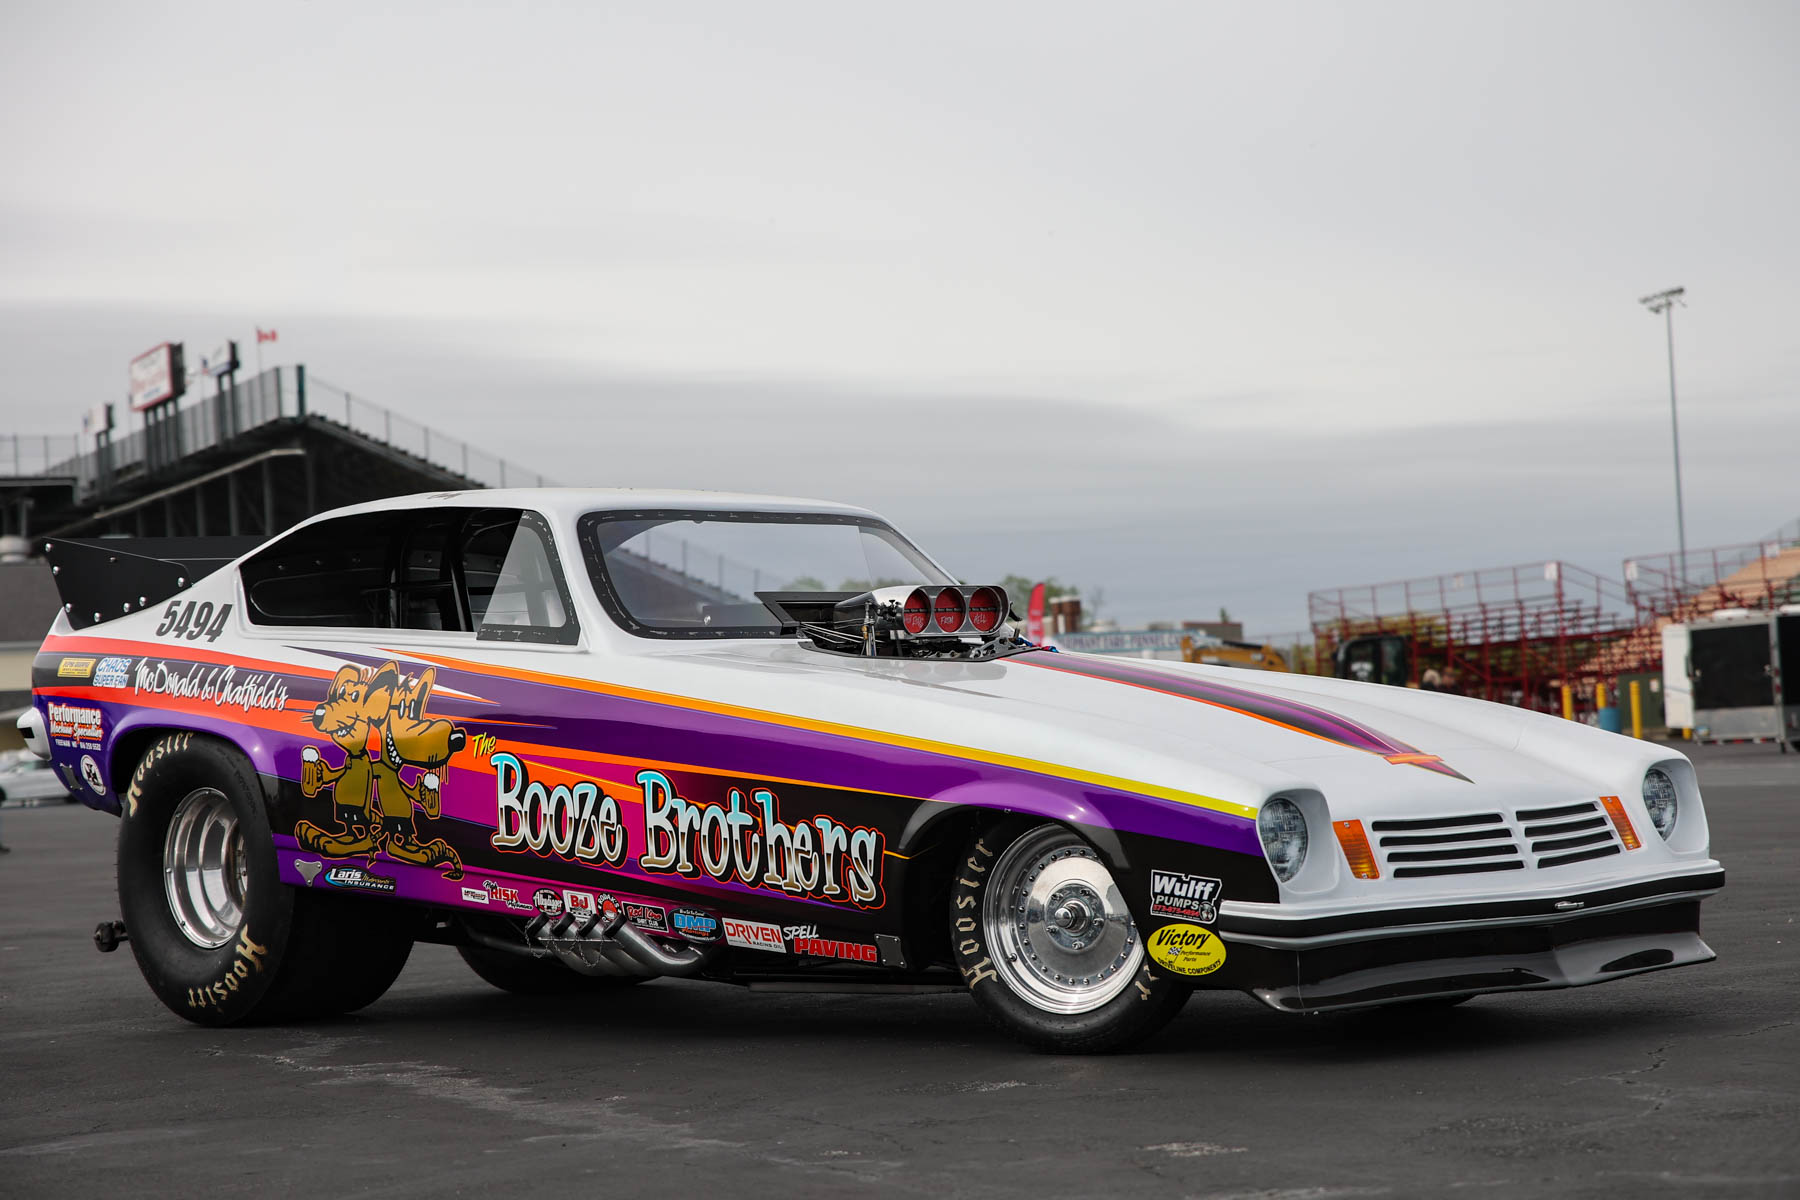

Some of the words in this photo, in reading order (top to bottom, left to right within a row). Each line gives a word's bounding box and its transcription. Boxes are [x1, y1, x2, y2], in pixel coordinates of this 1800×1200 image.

[155, 600, 233, 643] 5494
[96, 657, 132, 673] CHAOS
[93, 673, 114, 687] SUPER
[115, 674, 129, 688] FAN
[134, 657, 205, 699] McDonald
[215, 664, 288, 711] Chatfield's
[48, 702, 102, 725] Performance
[472, 732, 495, 758] The
[127, 731, 193, 817] Hoosier
[490, 752, 626, 864] Booze
[636, 769, 882, 906] Brothers
[330, 868, 362, 881] Laris
[344, 880, 395, 890] INSURANCE
[490, 887, 518, 902] RISK
[1154, 875, 1215, 900] Wulff
[627, 906, 643, 920] Red
[1156, 895, 1199, 910] PUMPS
[673, 913, 717, 932] DMP
[955, 838, 999, 990] Hoosier
[725, 922, 782, 944] DRIVEN
[782, 925, 819, 940] SPELL
[1156, 929, 1212, 949] Victory
[794, 937, 878, 962] PAVING
[187, 924, 268, 1008] Hoosier
[1157, 957, 1187, 974] DRIVELINE
[1187, 959, 1221, 974] COMPONENTS
